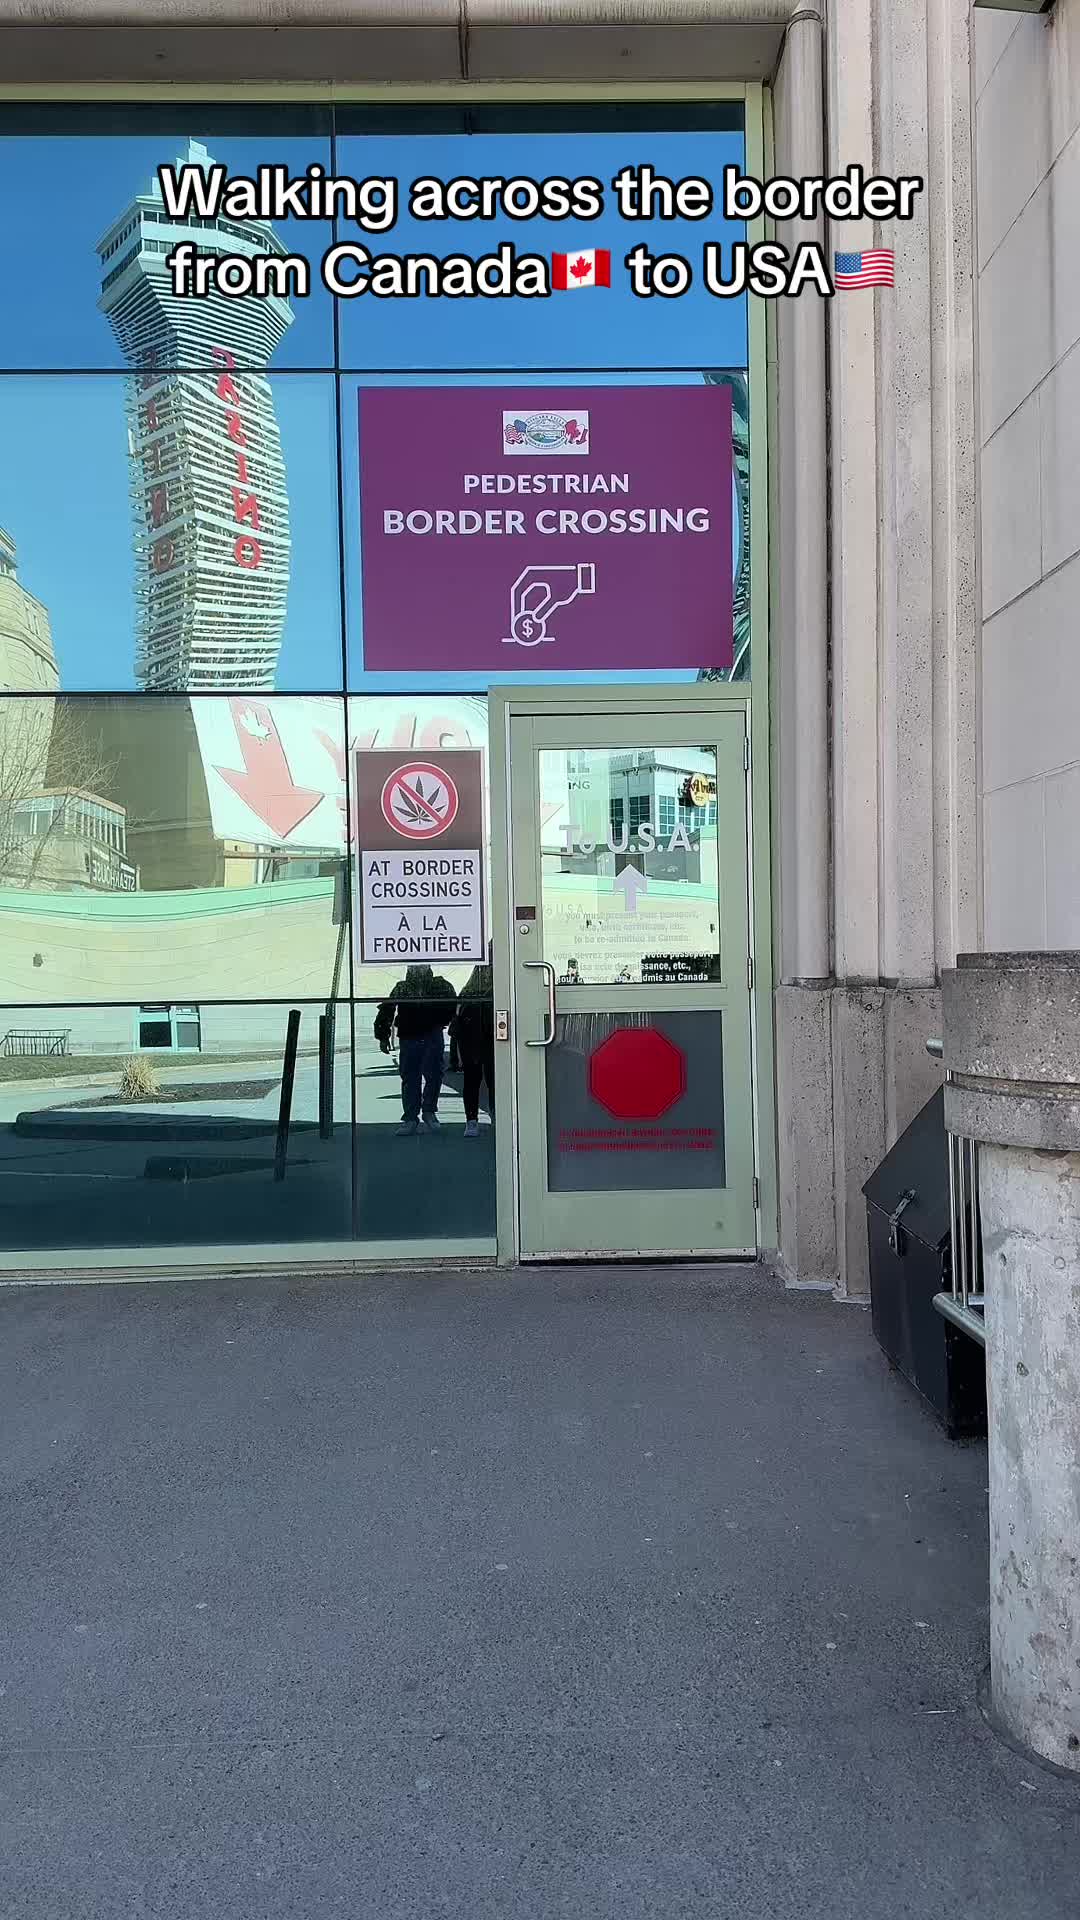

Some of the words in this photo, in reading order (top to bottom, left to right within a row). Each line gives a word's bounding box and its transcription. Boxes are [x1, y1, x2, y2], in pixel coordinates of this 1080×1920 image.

[463, 473, 629, 494] PEDESTRIAN
[383, 509, 527, 534] BORDER
[534, 508, 710, 534] CROSSING
[559, 824, 597, 854] To
[607, 822, 700, 853] U.S.A.
[368, 860, 391, 876] AT
[403, 859, 474, 876] BORDER
[371, 881, 472, 898] CROSSINGS
[397, 912, 411, 931] À
[423, 915, 448, 931] LA
[373, 932, 472, 953] FRONTIÈRE
[665, 974, 676, 982] au
[677, 972, 709, 982] Canada
